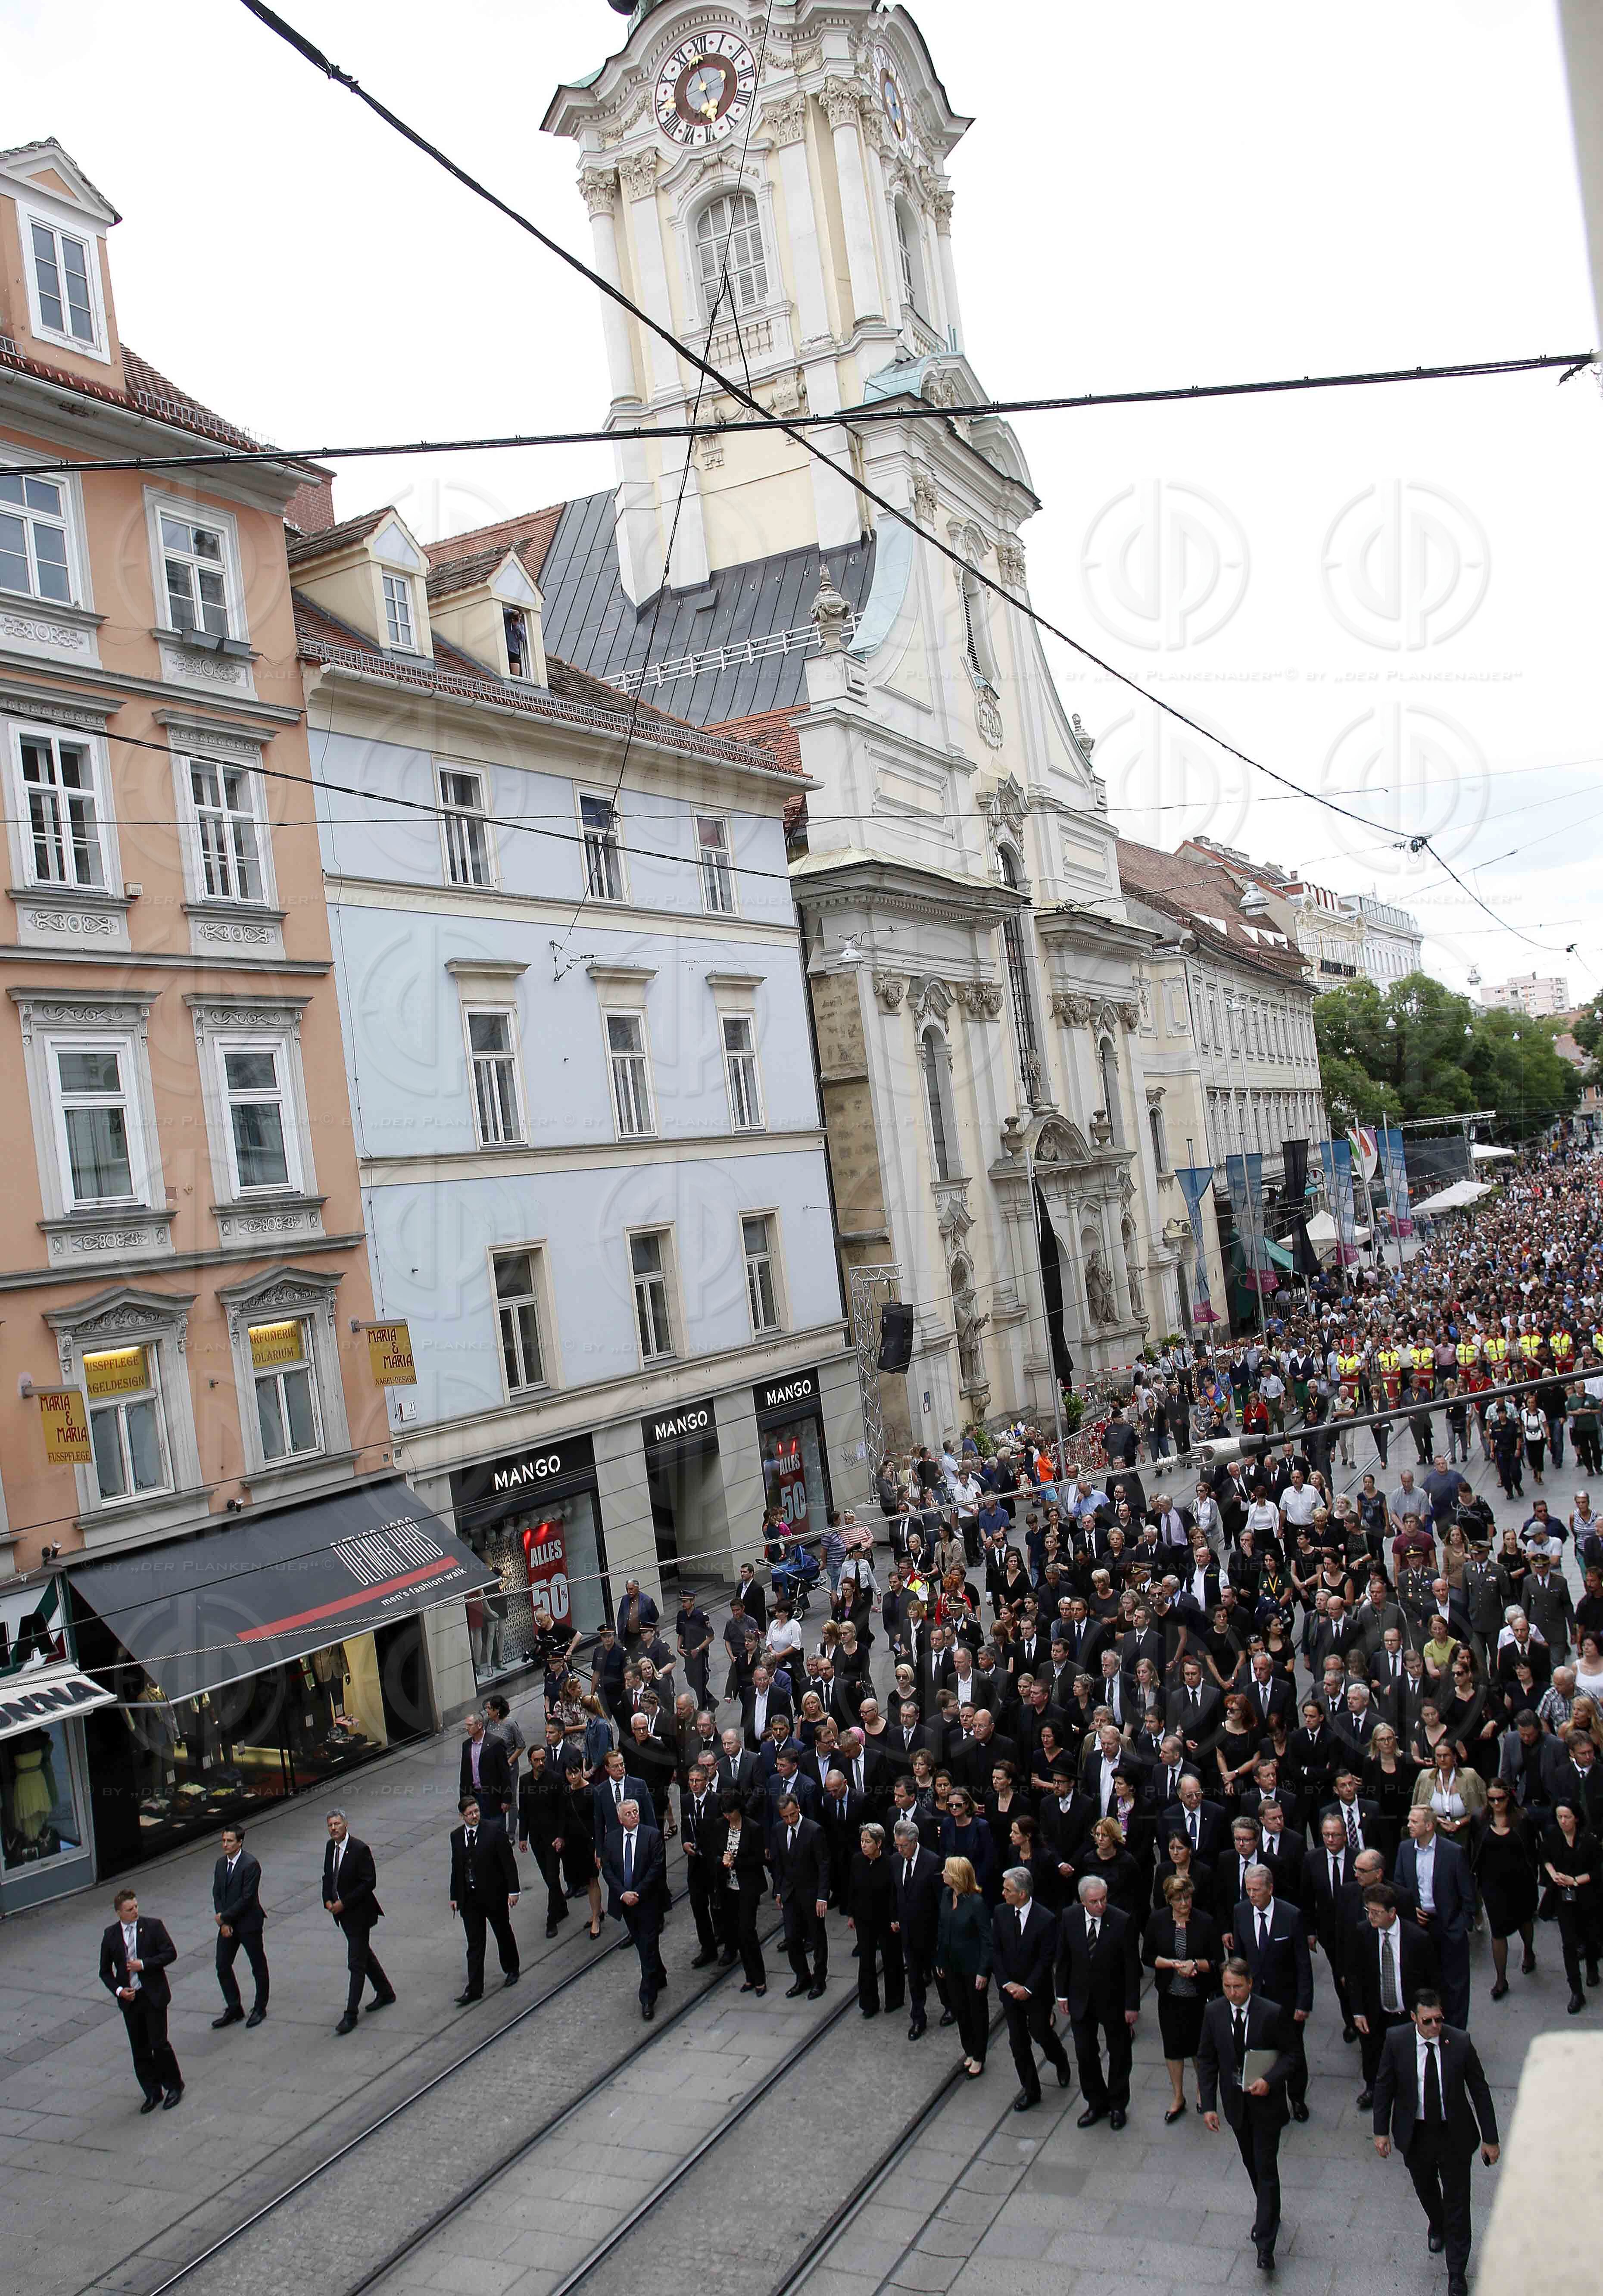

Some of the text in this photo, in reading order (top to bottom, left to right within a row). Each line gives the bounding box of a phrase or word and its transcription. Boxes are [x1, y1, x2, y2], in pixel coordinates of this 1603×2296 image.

[368, 1328, 396, 1343] MARIA
[392, 1342, 399, 1354] &
[84, 1356, 139, 1373] USSPFLEGE
[383, 1354, 413, 1369] MARIA
[87, 1376, 144, 1393] AGELDESIGN
[767, 1379, 811, 1406] MANGO
[41, 1394, 70, 1411] MARIA
[409, 1402, 415, 1412] 21
[65, 1411, 72, 1426] &
[655, 1410, 708, 1440] MANGO
[56, 1427, 87, 1442] MARIA
[48, 1451, 90, 1462] FUSSPFLEGE
[779, 1454, 800, 1476] ALLES
[494, 1455, 561, 1491] MANGO
[780, 1482, 806, 1525] 50
[530, 1539, 563, 1568] ALLES
[380, 1567, 468, 1607] men's fashion walk
